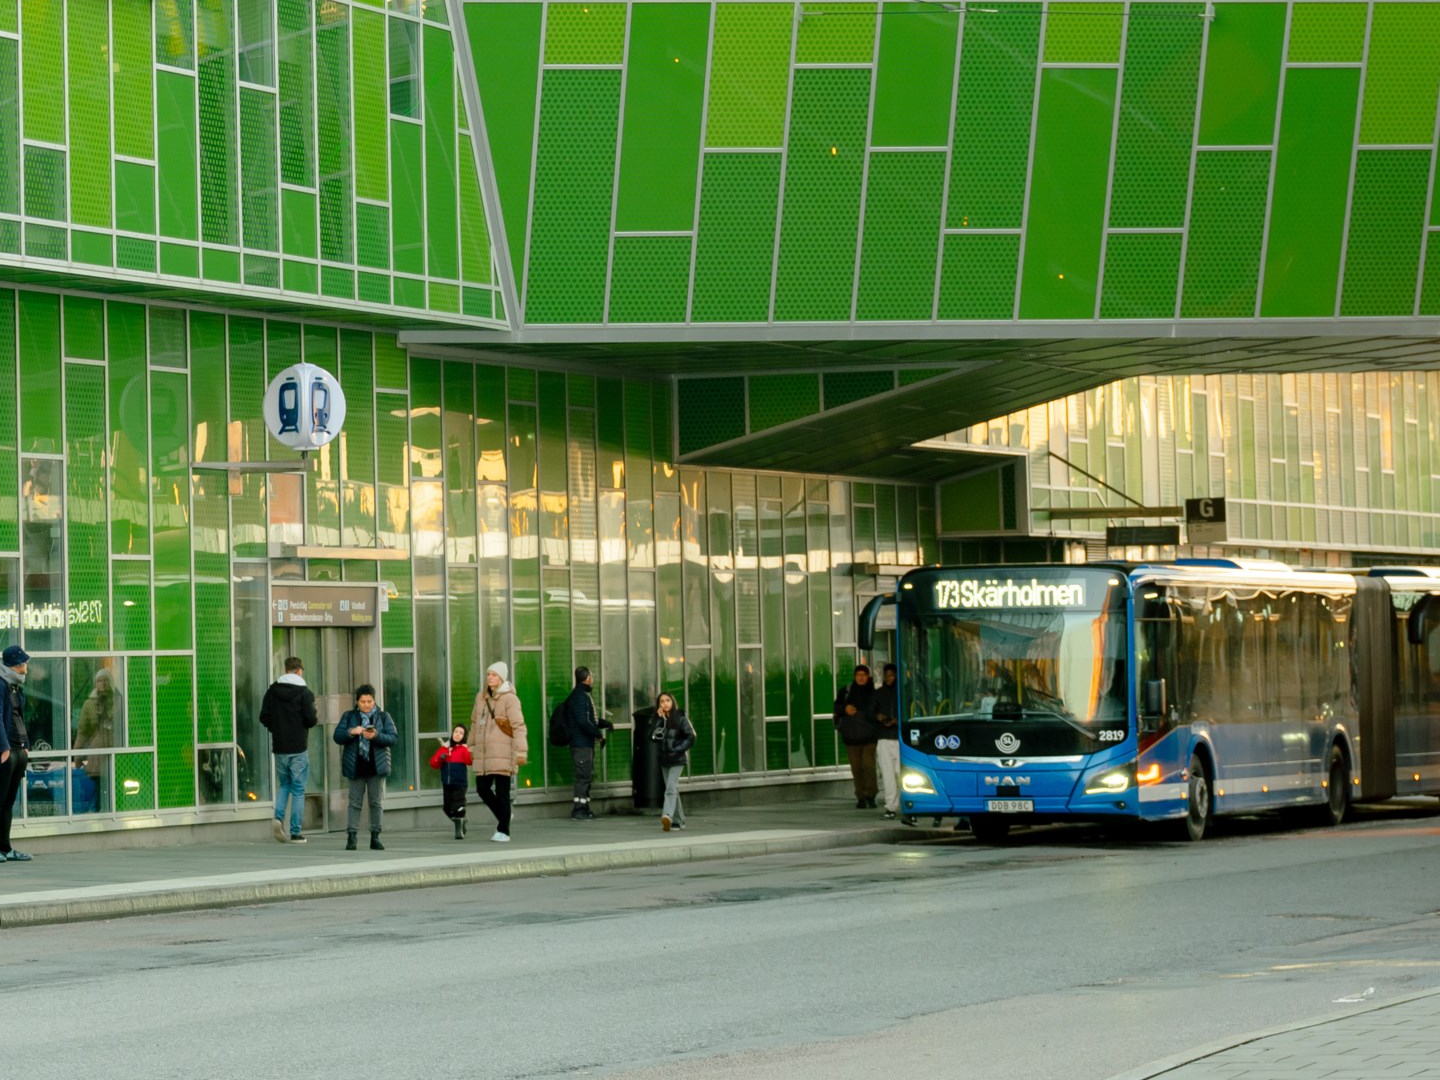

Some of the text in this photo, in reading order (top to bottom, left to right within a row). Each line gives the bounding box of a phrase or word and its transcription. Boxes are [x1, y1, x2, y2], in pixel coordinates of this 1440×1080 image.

[1200, 498, 1214, 518] G
[935, 579, 1083, 608] 173 Skärholmen
[1003, 736, 1013, 745] SL
[1098, 730, 1125, 741] 2819
[984, 775, 1031, 786] MAN
